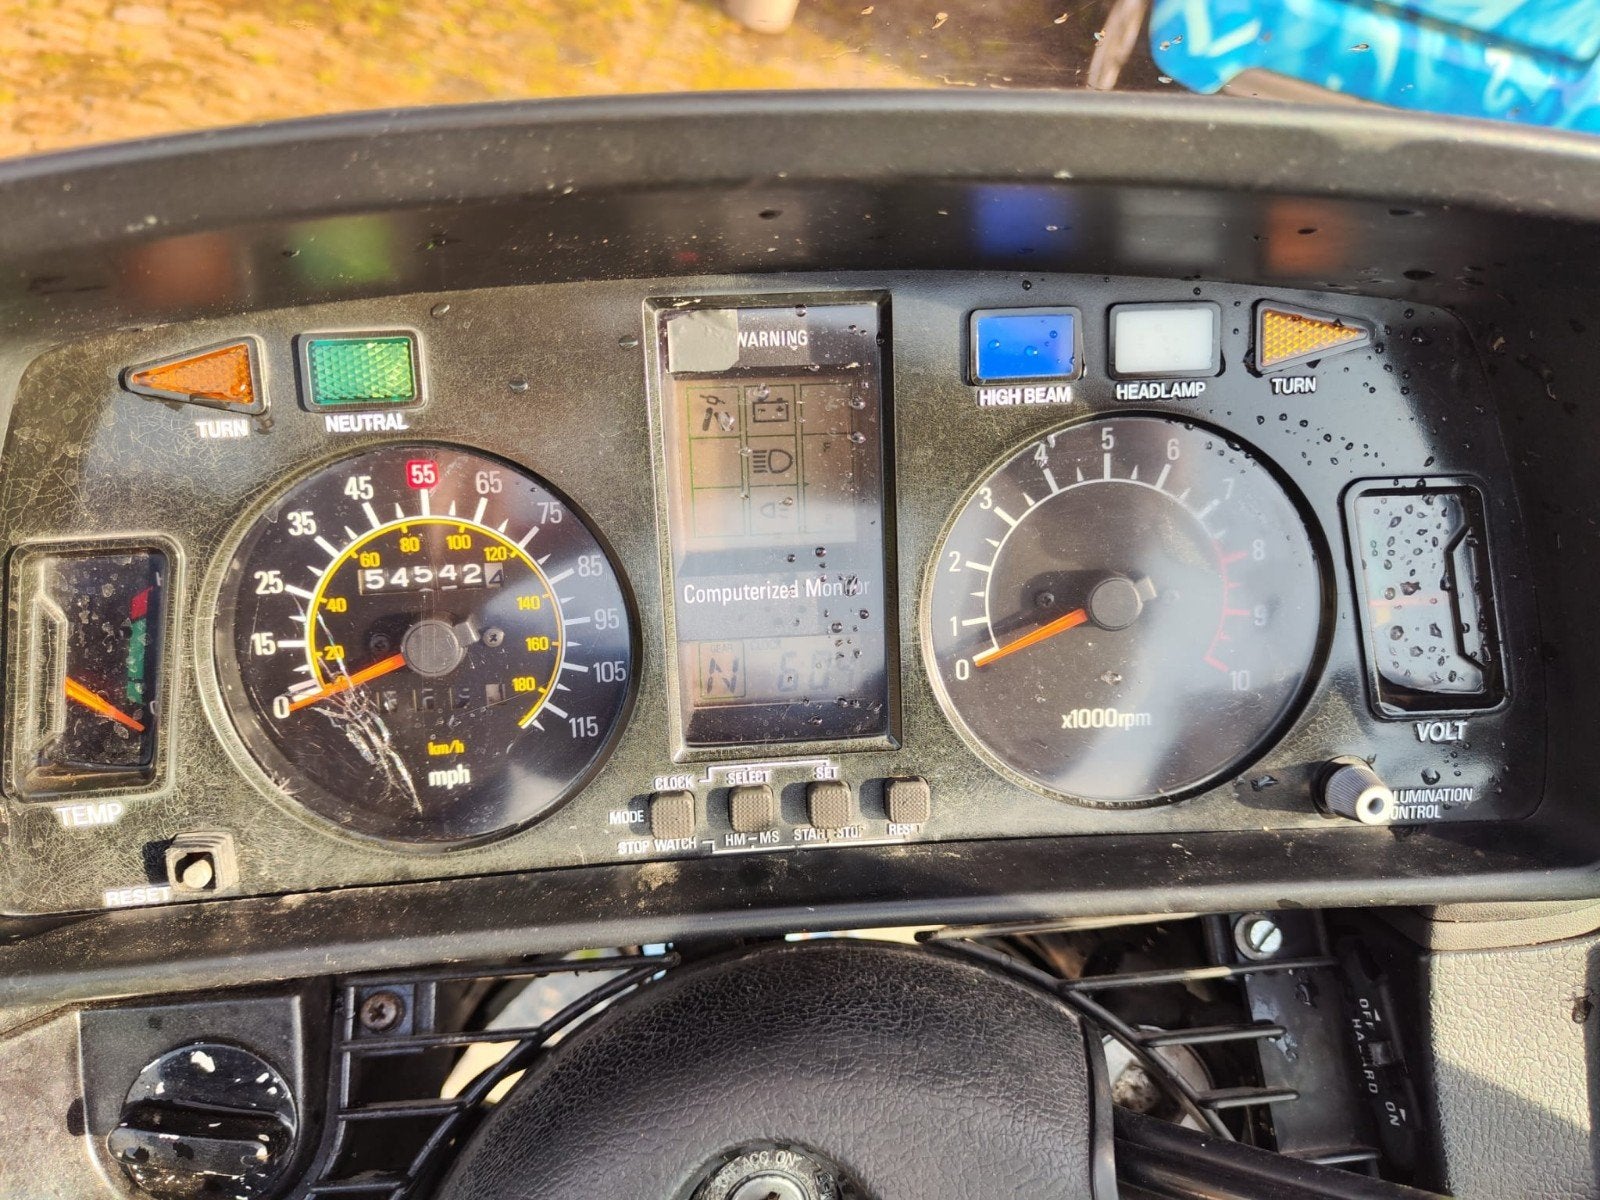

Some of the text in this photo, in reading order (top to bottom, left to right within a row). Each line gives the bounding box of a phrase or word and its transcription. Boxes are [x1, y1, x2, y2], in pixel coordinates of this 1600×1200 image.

[737, 329, 809, 347] WARNING
[979, 385, 1072, 406] HIGH BEAM
[1116, 381, 1206, 400] HEADLAMP
[1272, 377, 1317, 395] TURN
[195, 418, 249, 439] TURN
[325, 412, 410, 434] NEUTRAL
[1101, 426, 1115, 450] 5
[1166, 437, 1180, 461] 6
[1033, 441, 1048, 463] 4
[411, 463, 436, 485] 55
[475, 470, 503, 495] 65
[344, 475, 374, 501] 45
[979, 487, 993, 510] 3
[1222, 477, 1235, 501] 7
[286, 510, 317, 537] 35
[537, 500, 563, 525] 75
[399, 536, 421, 553] 80
[445, 534, 472, 550] 100
[1252, 538, 1266, 561] 8
[359, 551, 381, 568] 60
[484, 546, 508, 562] 120
[948, 550, 962, 573] 2
[577, 554, 603, 578] 85
[253, 570, 284, 596] 25
[683, 576, 870, 606] Computerized Monor
[325, 597, 347, 613] 40
[516, 595, 541, 611] 140
[593, 608, 620, 630] 95
[950, 615, 958, 637] 1
[1254, 604, 1267, 627] 9
[251, 631, 277, 656] 15
[323, 645, 345, 661] 20
[525, 636, 549, 652] 160
[593, 660, 627, 684] 105
[955, 658, 970, 681] 0
[1230, 669, 1250, 692] 10
[511, 676, 536, 692] 180
[273, 695, 290, 719] 0
[568, 715, 599, 739] 115
[1416, 721, 1468, 742] VOLT
[427, 739, 466, 756] km/h
[428, 763, 471, 790] mph
[654, 775, 695, 791] CLOCK
[726, 770, 772, 785] SELECT
[815, 765, 839, 779] SET
[1392, 787, 1473, 804] LUMINATION
[54, 801, 124, 828] TEMP
[609, 809, 645, 825] MODE
[1390, 804, 1442, 820] ONTROL
[888, 823, 922, 836] REST
[617, 836, 697, 855] STOP WATCH
[104, 885, 172, 909] RESET
[1384, 1100, 1401, 1127] ON
